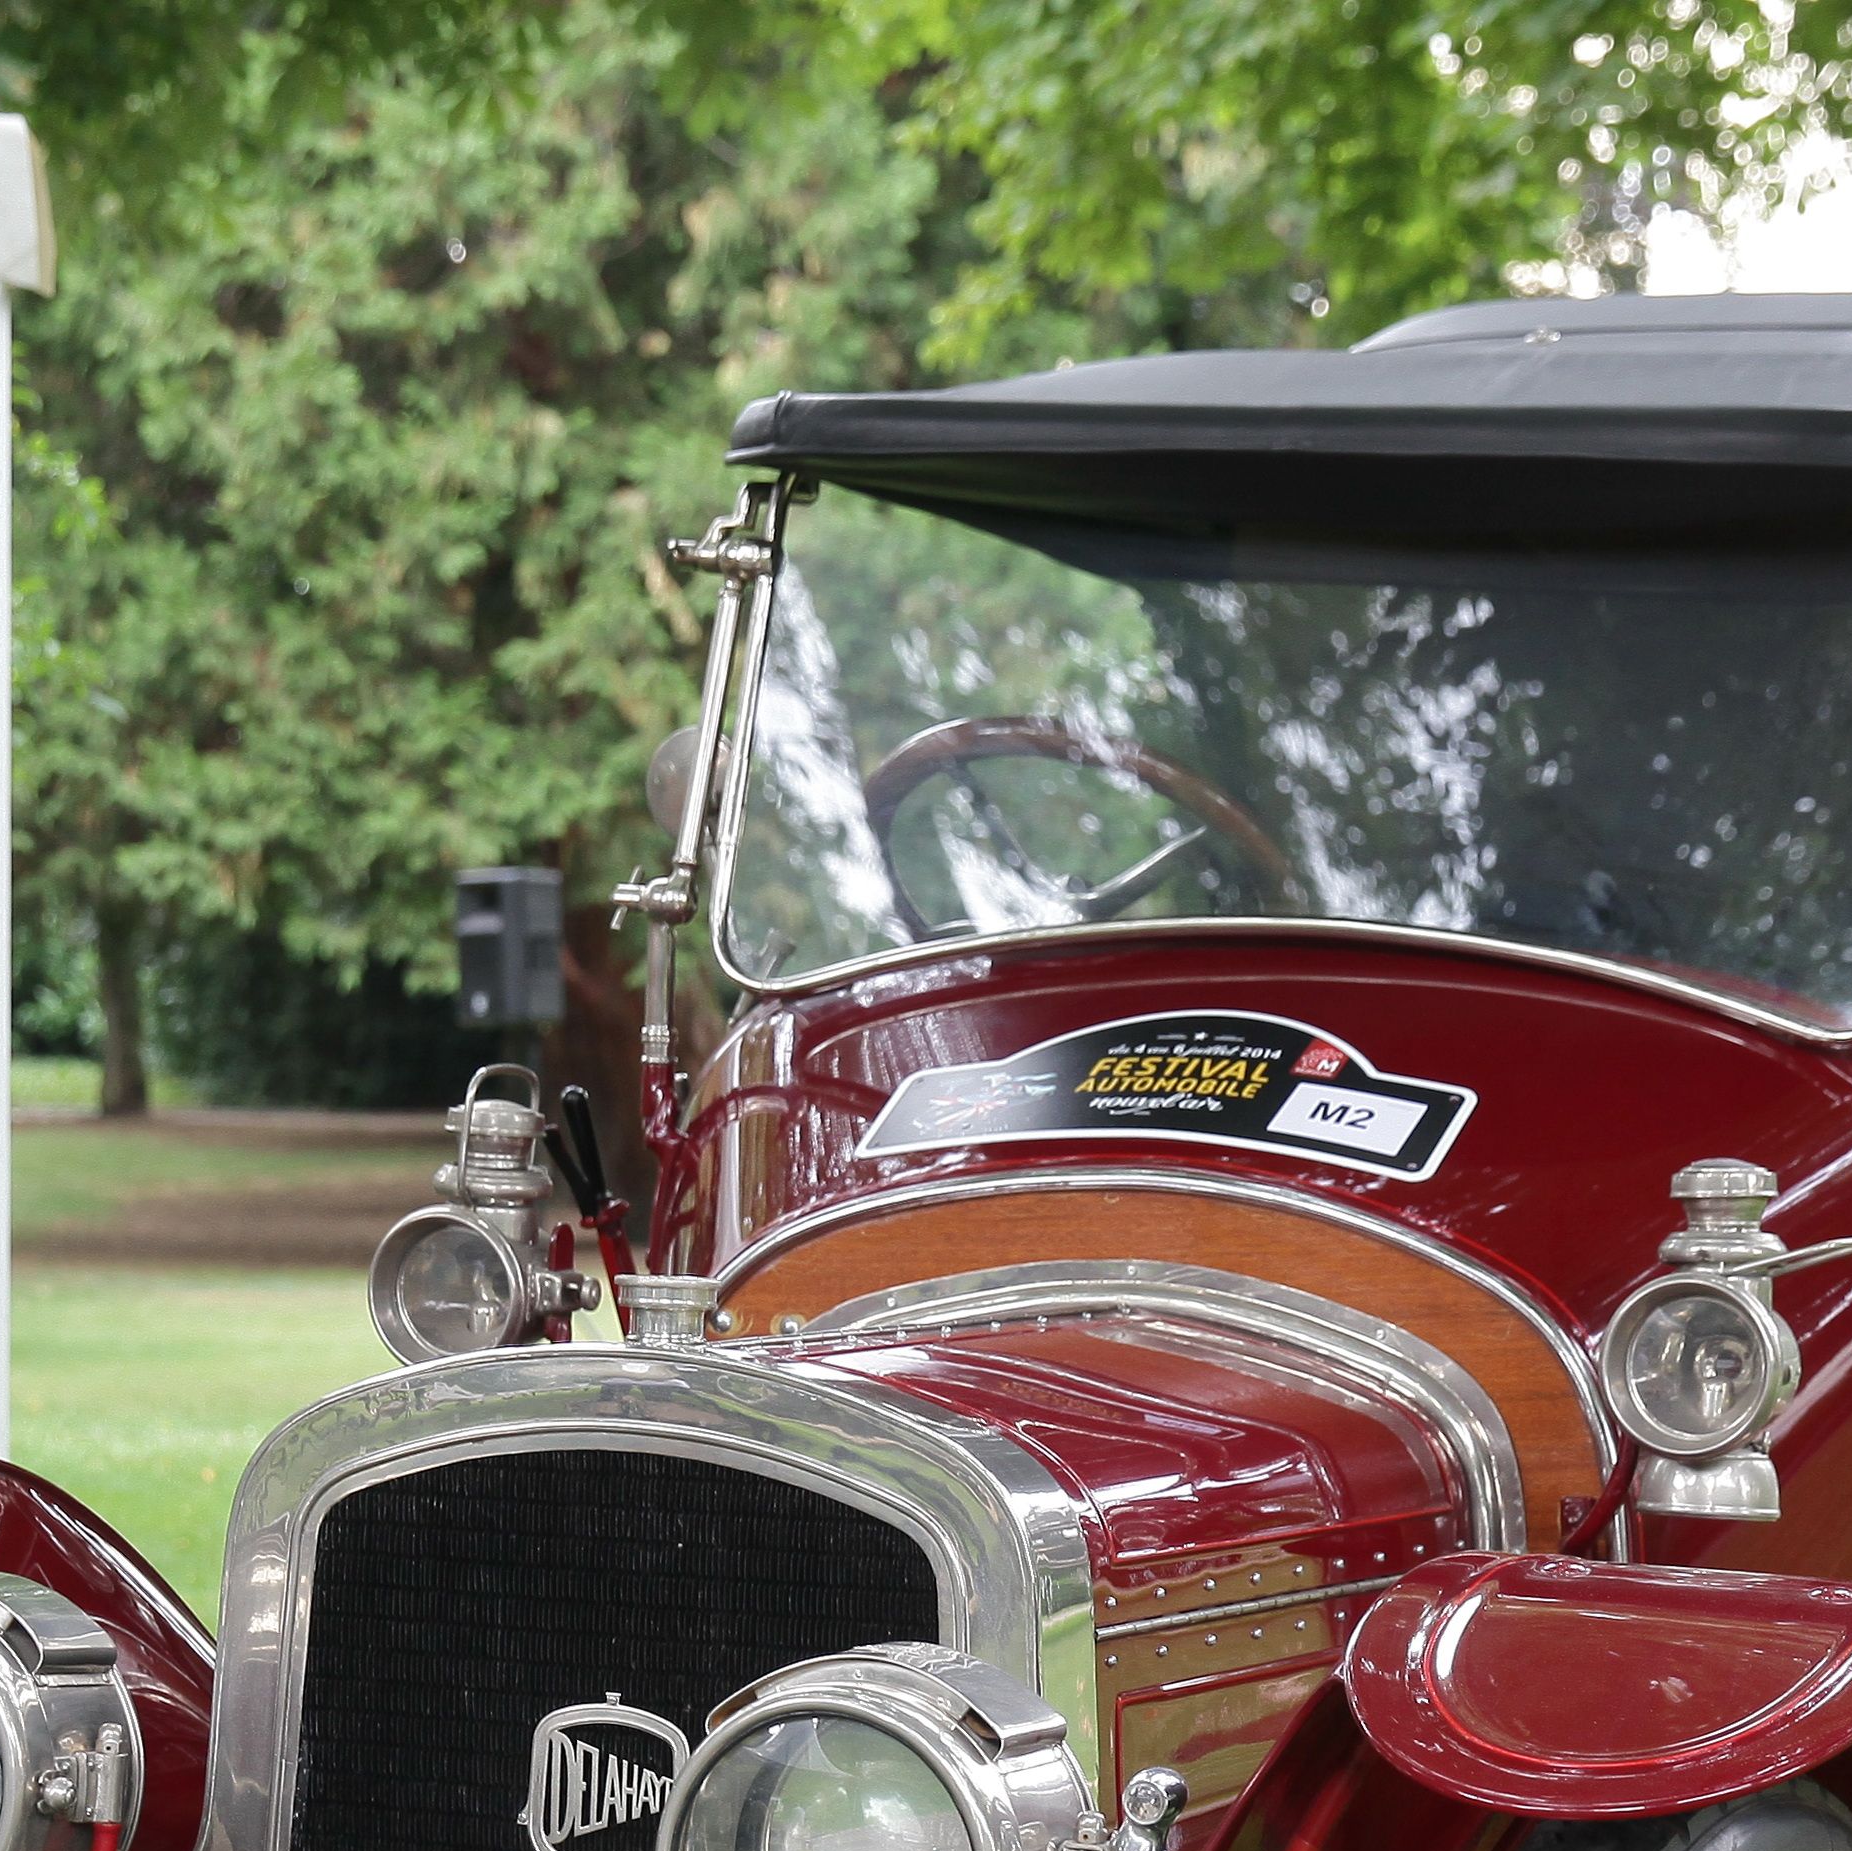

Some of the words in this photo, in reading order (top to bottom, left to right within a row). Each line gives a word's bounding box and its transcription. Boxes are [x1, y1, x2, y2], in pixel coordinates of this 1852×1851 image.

[1134, 1043, 1146, 1054] 4
[1240, 1046, 1282, 1059] 2014
[1089, 1056, 1269, 1083] FESTIVAL
[1074, 1077, 1262, 1099] AUTOMOBILE
[1309, 1101, 1375, 1130] M2
